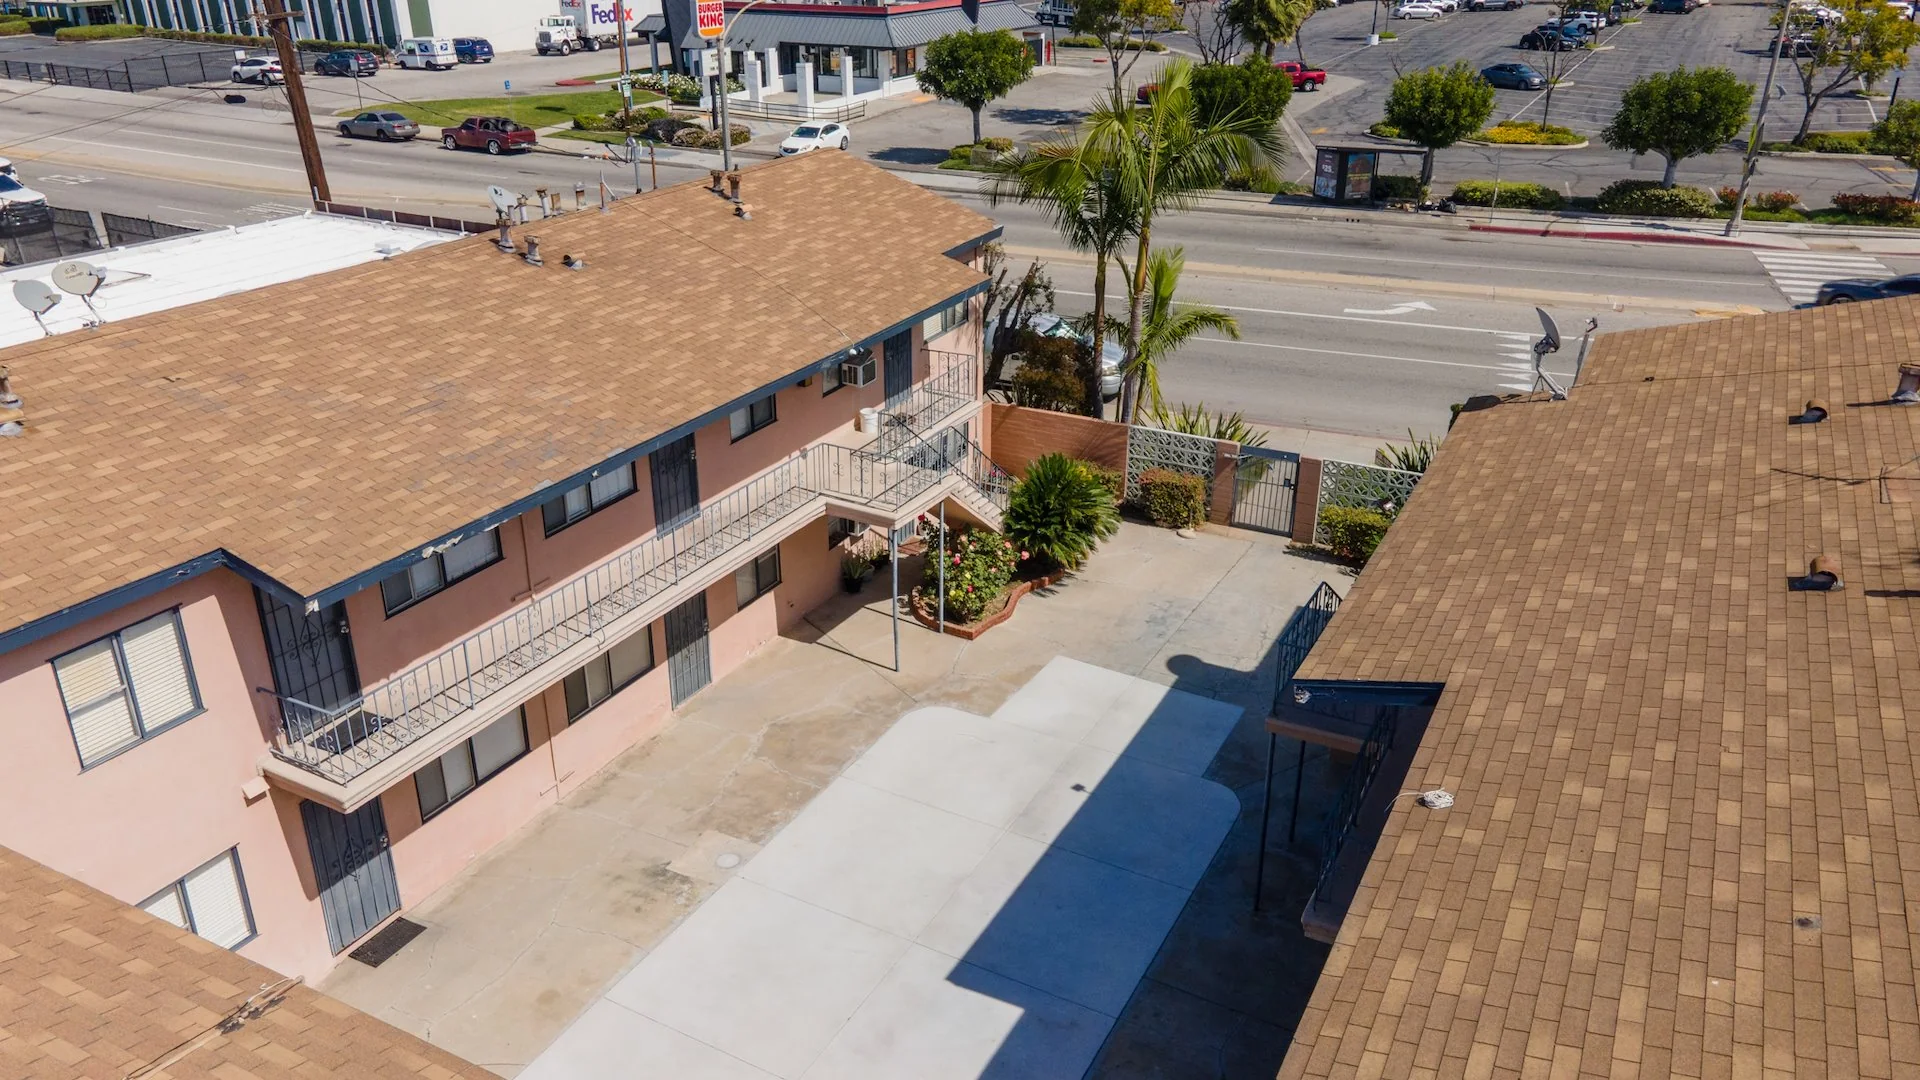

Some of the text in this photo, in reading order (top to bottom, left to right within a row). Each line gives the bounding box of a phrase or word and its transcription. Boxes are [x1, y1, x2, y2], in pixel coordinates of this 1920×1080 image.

[562, 0, 581, 8] FedEx
[698, 3, 722, 13] BURGER
[699, 13, 724, 28] KING
